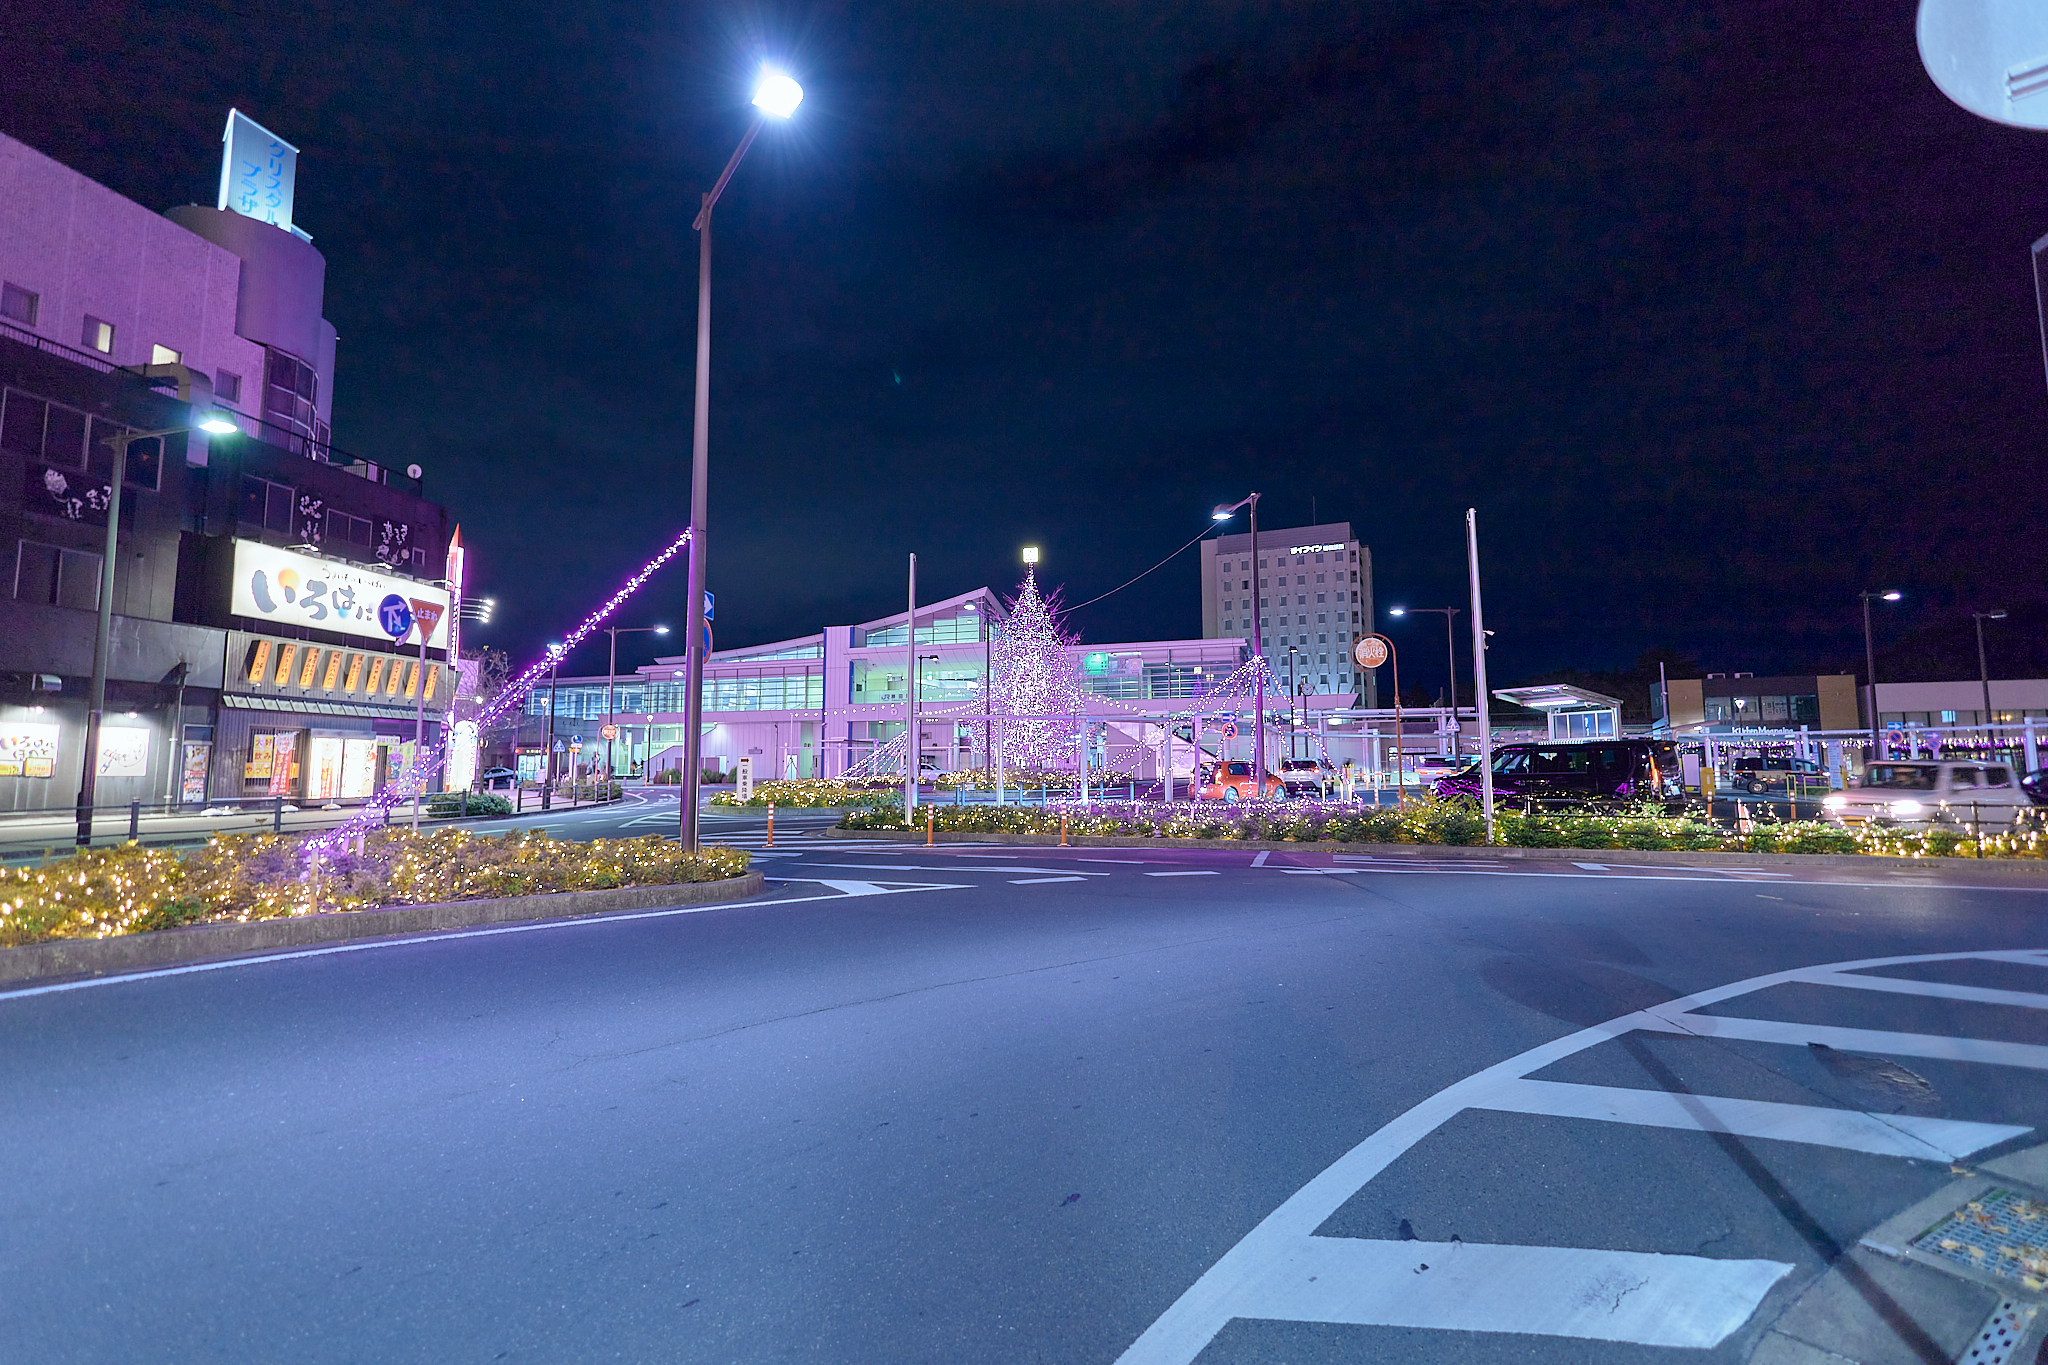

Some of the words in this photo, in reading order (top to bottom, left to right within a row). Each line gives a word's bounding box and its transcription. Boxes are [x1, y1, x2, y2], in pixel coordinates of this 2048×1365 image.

[237, 160, 262, 213] プラザ
[265, 141, 285, 226] クリスタル
[252, 569, 373, 621] いろはに
[416, 607, 439, 622] 止まれ
[1359, 646, 1385, 659] 消火栓
